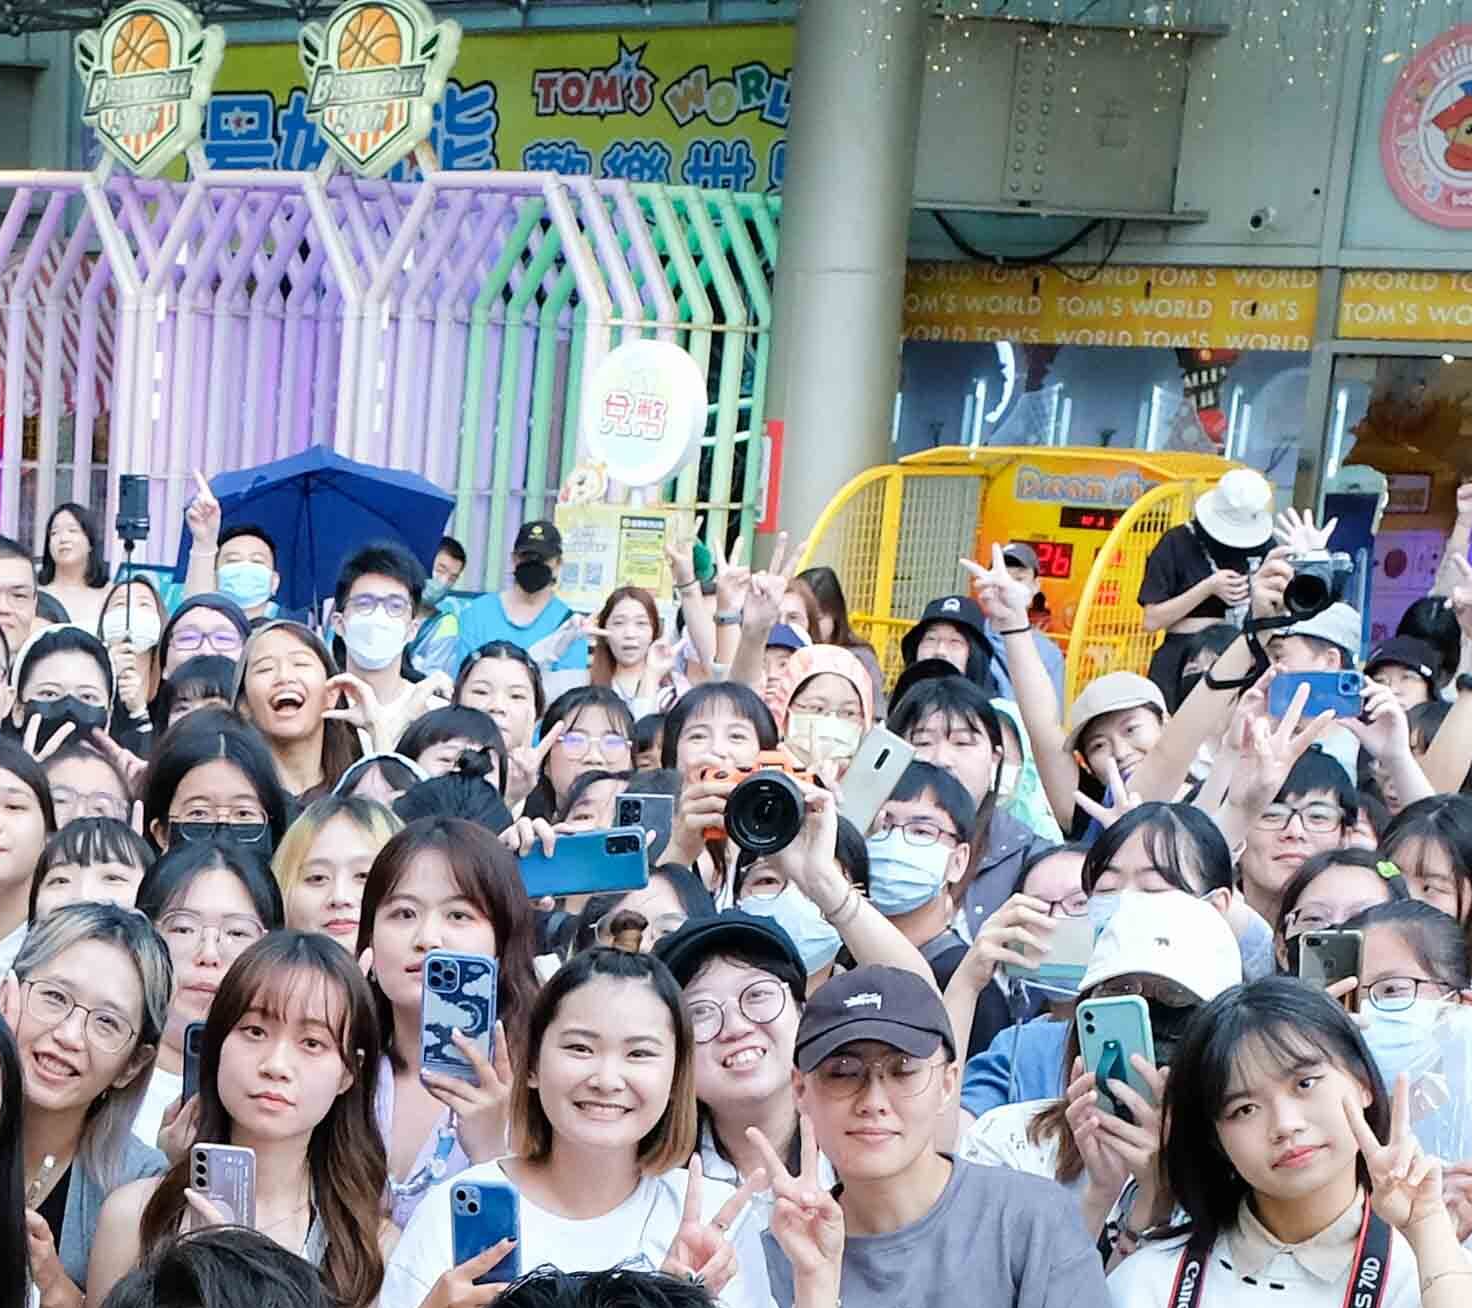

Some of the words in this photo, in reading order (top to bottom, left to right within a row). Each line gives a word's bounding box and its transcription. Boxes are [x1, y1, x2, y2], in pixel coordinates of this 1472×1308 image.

[534, 68, 656, 118] TOM'S
[664, 63, 792, 127] WORL
[965, 295, 1041, 316] WORLD
[1057, 297, 1122, 317] TOM'S
[1131, 298, 1213, 319] WORLD
[1342, 302, 1418, 324] TOM'S
[1358, 1256, 1381, 1290] 70D
